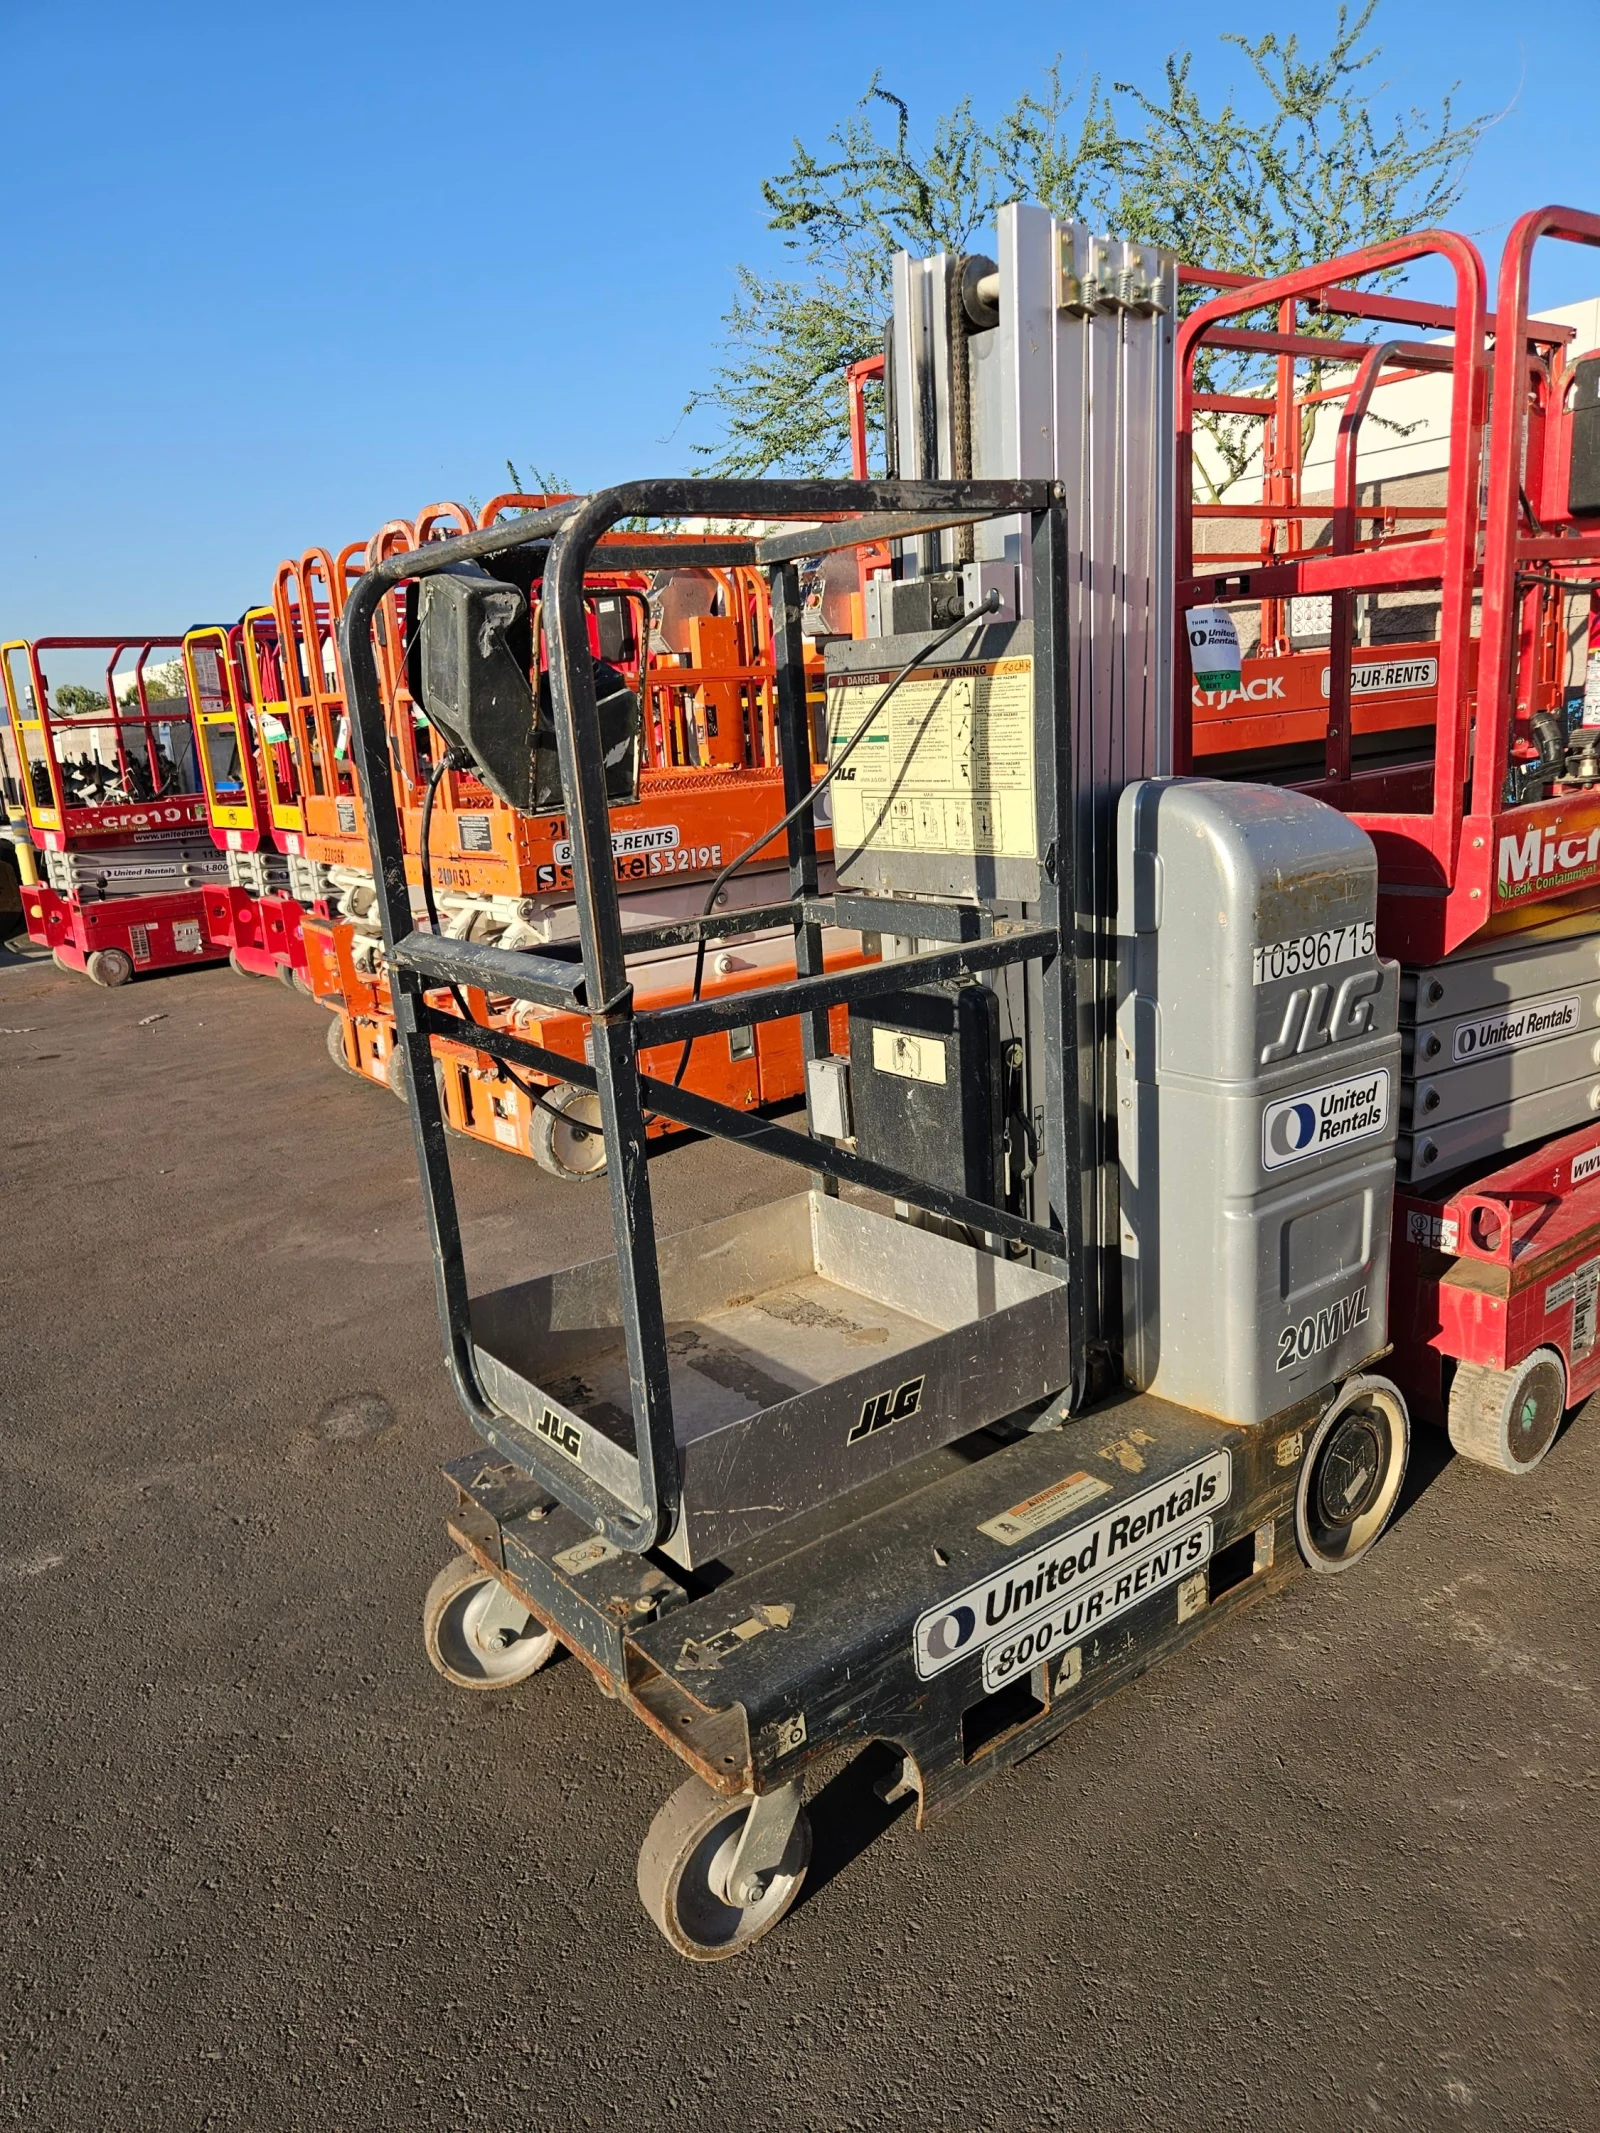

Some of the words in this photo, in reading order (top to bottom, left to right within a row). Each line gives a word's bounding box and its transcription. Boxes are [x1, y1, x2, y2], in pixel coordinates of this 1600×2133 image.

[1208, 629, 1235, 638] United
[1208, 637, 1238, 646] Rentals
[847, 674, 880, 686] DANGER
[941, 665, 987, 679] WARNING
[1192, 676, 1287, 711] KYJACK
[1351, 664, 1430, 688] 0-UR-RENTS
[834, 768, 857, 780] JLG
[114, 868, 143, 877] United
[144, 867, 176, 876] Rentals
[650, 845, 722, 874] S3219E
[1508, 880, 1533, 899] Leak
[1536, 863, 1597, 893] Containment
[1257, 921, 1375, 982] 10596715
[1261, 969, 1381, 1065] JLG
[1479, 1015, 1526, 1047] United
[1526, 1005, 1573, 1034] Rentals
[1320, 1080, 1379, 1118] United
[1319, 1105, 1381, 1142] Rentals
[1276, 1285, 1370, 1373] 20MVL
[846, 1374, 925, 1447] JLG
[535, 1406, 582, 1463] JLG
[985, 1531, 1100, 1627] United
[1107, 1472, 1218, 1557] Rentals
[996, 1531, 1203, 1678] 800-UR-RENTS
